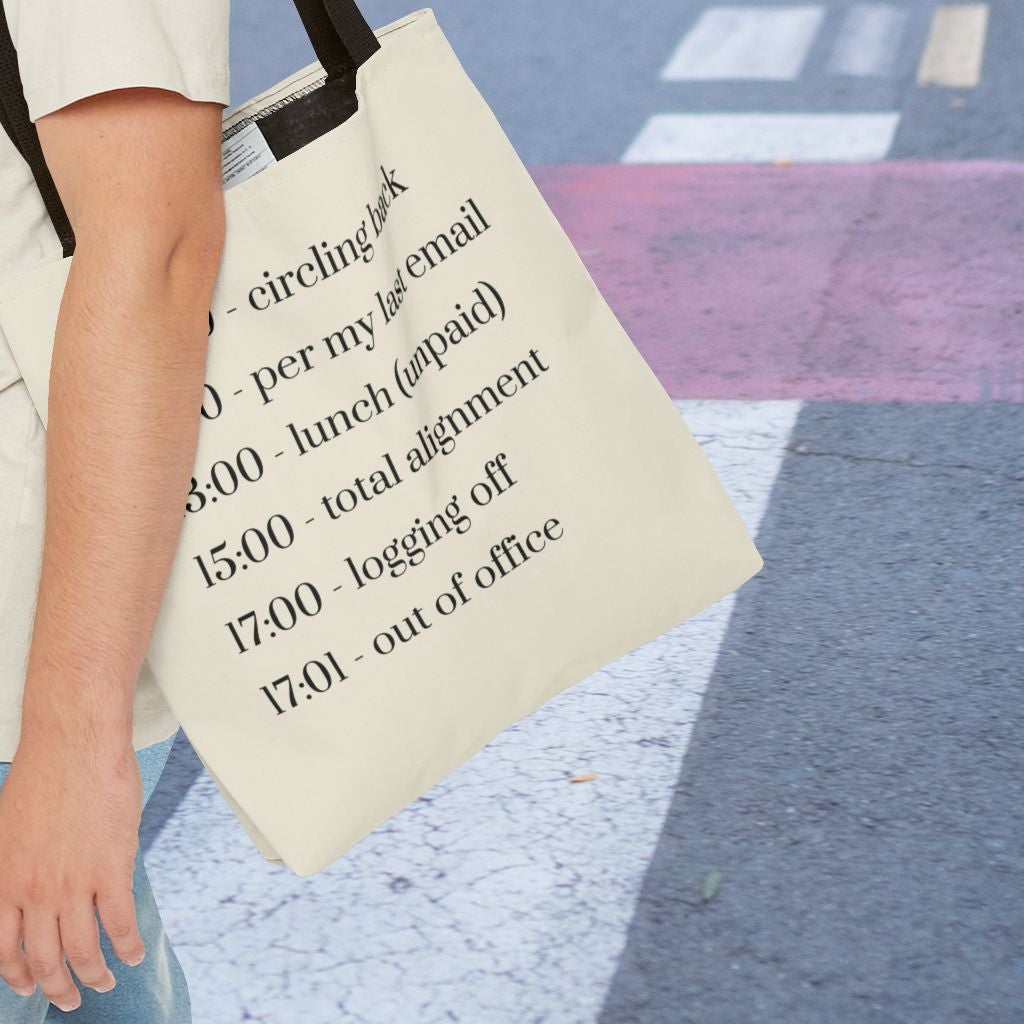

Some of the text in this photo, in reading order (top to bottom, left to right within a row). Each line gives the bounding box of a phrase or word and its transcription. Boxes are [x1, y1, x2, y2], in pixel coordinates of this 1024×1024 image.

[247, 220, 374, 311] circling
[365, 165, 409, 238] back
[250, 345, 315, 405] per
[322, 310, 375, 360] my
[374, 268, 408, 325] last
[405, 198, 492, 278] email
[183, 447, 264, 518] 3:00
[286, 383, 395, 457] lunch
[394, 280, 507, 399] (unpaid)
[193, 514, 295, 589] 15:00
[320, 453, 403, 521] total
[406, 348, 551, 473] alignment
[224, 582, 323, 654] 17:00
[343, 494, 472, 590] logging
[470, 452, 518, 507] off
[259, 651, 349, 715] 17:01
[373, 606, 433, 655] out
[435, 571, 472, 616] of
[474, 517, 565, 589] office
